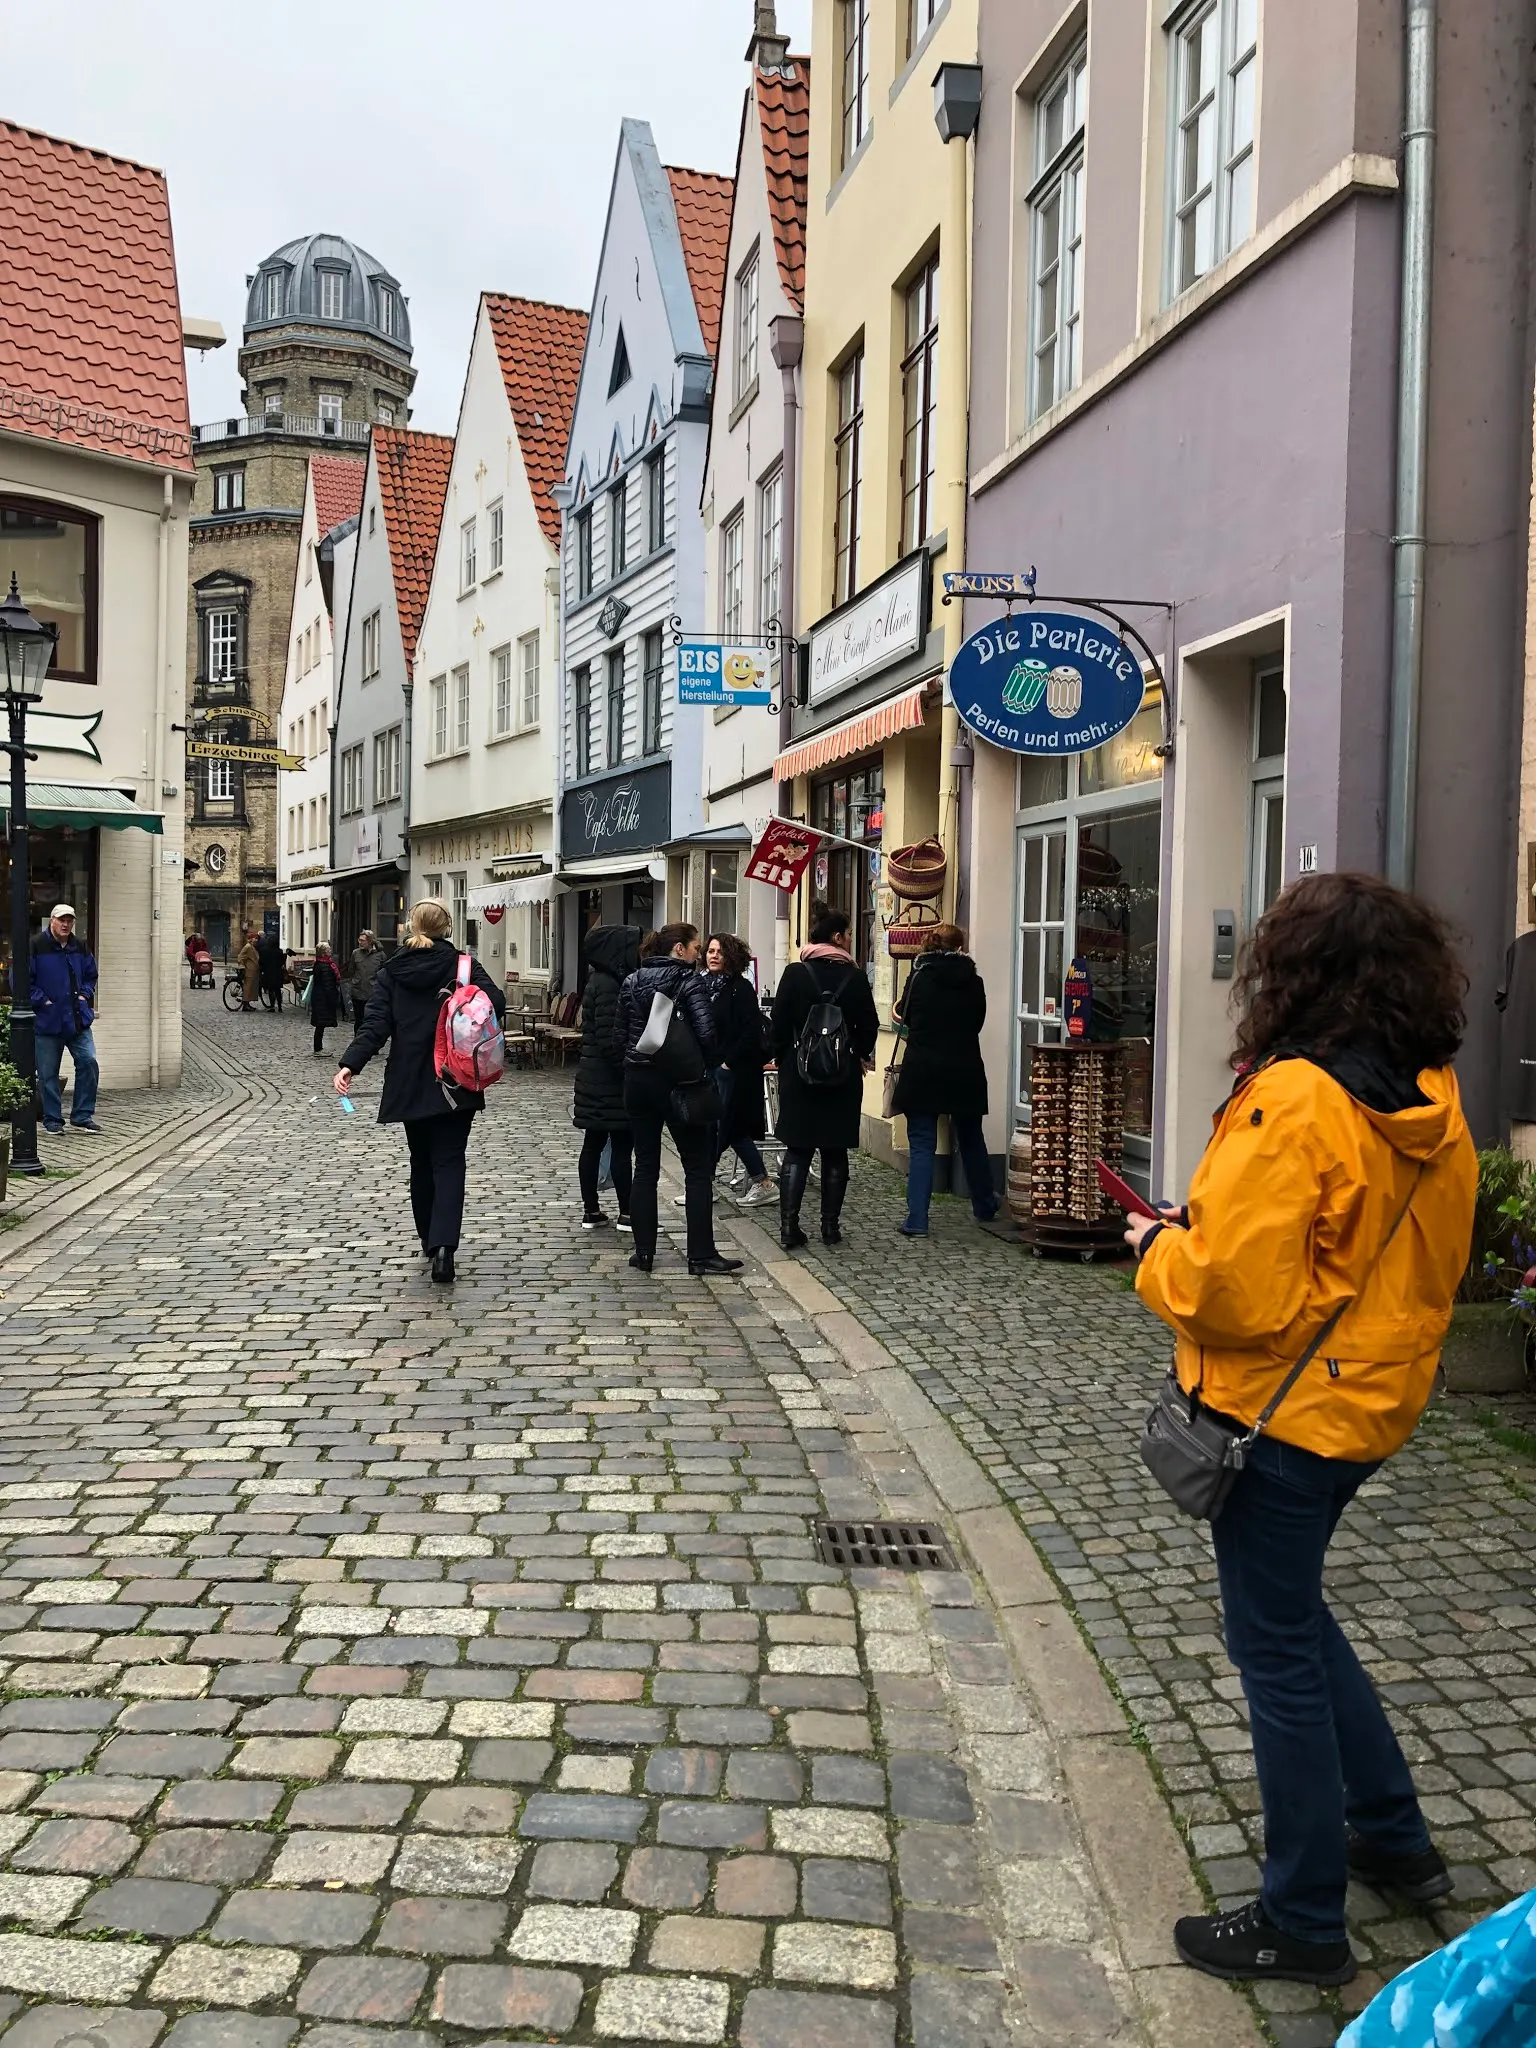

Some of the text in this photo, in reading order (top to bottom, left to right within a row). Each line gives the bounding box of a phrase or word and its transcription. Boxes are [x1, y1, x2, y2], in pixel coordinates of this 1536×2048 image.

[679, 649, 721, 673] EIS
[971, 621, 1134, 682] Die Perlerie
[681, 678, 712, 689] eigene
[681, 689, 735, 704] Herstellung
[213, 706, 264, 720] Schnoor
[965, 702, 1123, 748] Perlen und mehr...
[191, 742, 279, 763] Erzgebirge
[579, 791, 610, 853] Café
[767, 824, 809, 842] Gelati
[1303, 848, 1312, 869] 10
[752, 861, 796, 889] EIS
